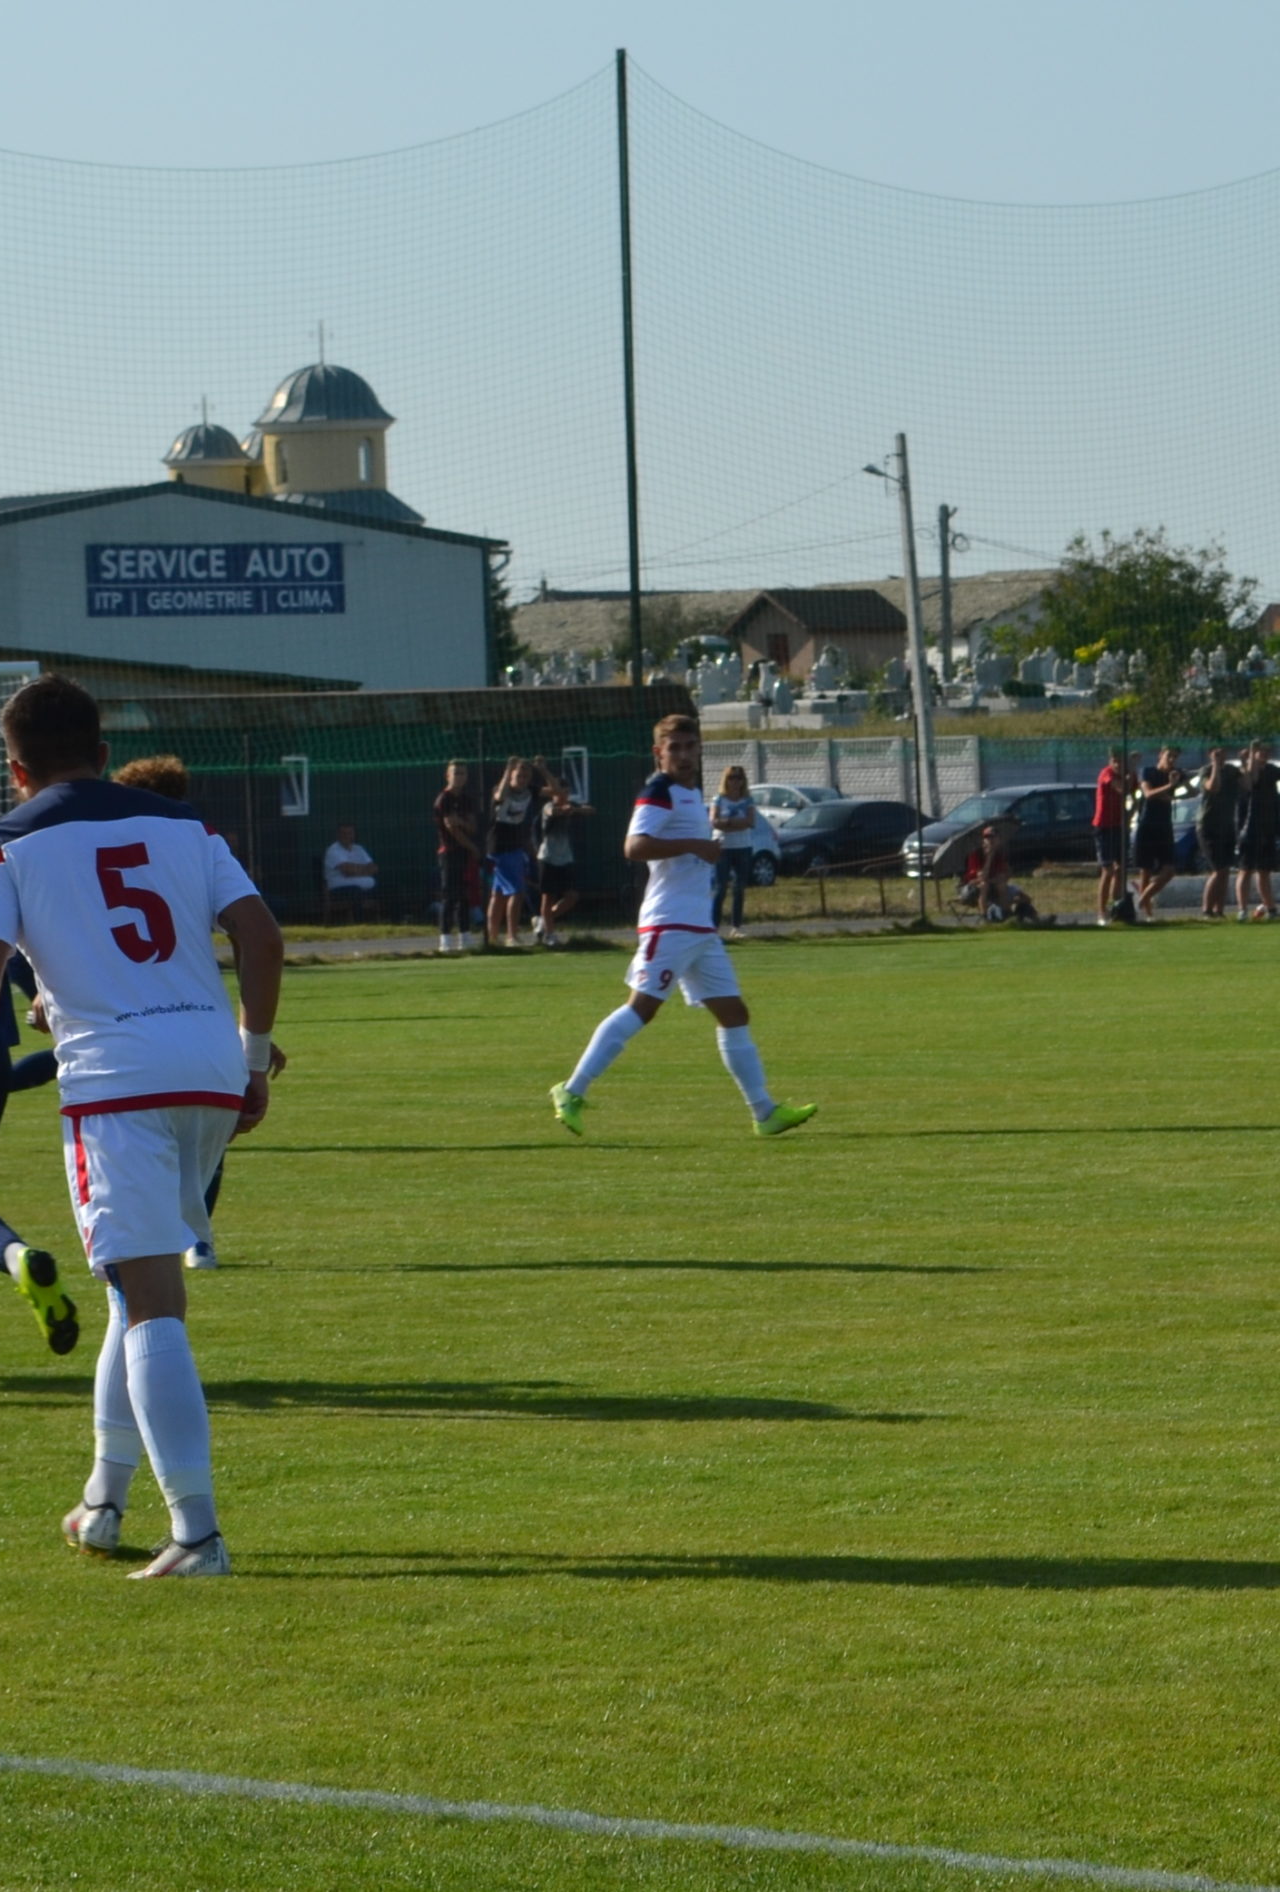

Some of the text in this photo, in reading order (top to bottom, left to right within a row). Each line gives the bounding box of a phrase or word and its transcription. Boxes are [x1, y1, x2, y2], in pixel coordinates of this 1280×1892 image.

[100, 547, 331, 579] SERVICE AUTO
[95, 589, 334, 610] ITP GEOMETRIE CLIMA
[96, 841, 177, 965] 5
[659, 969, 674, 991] 9
